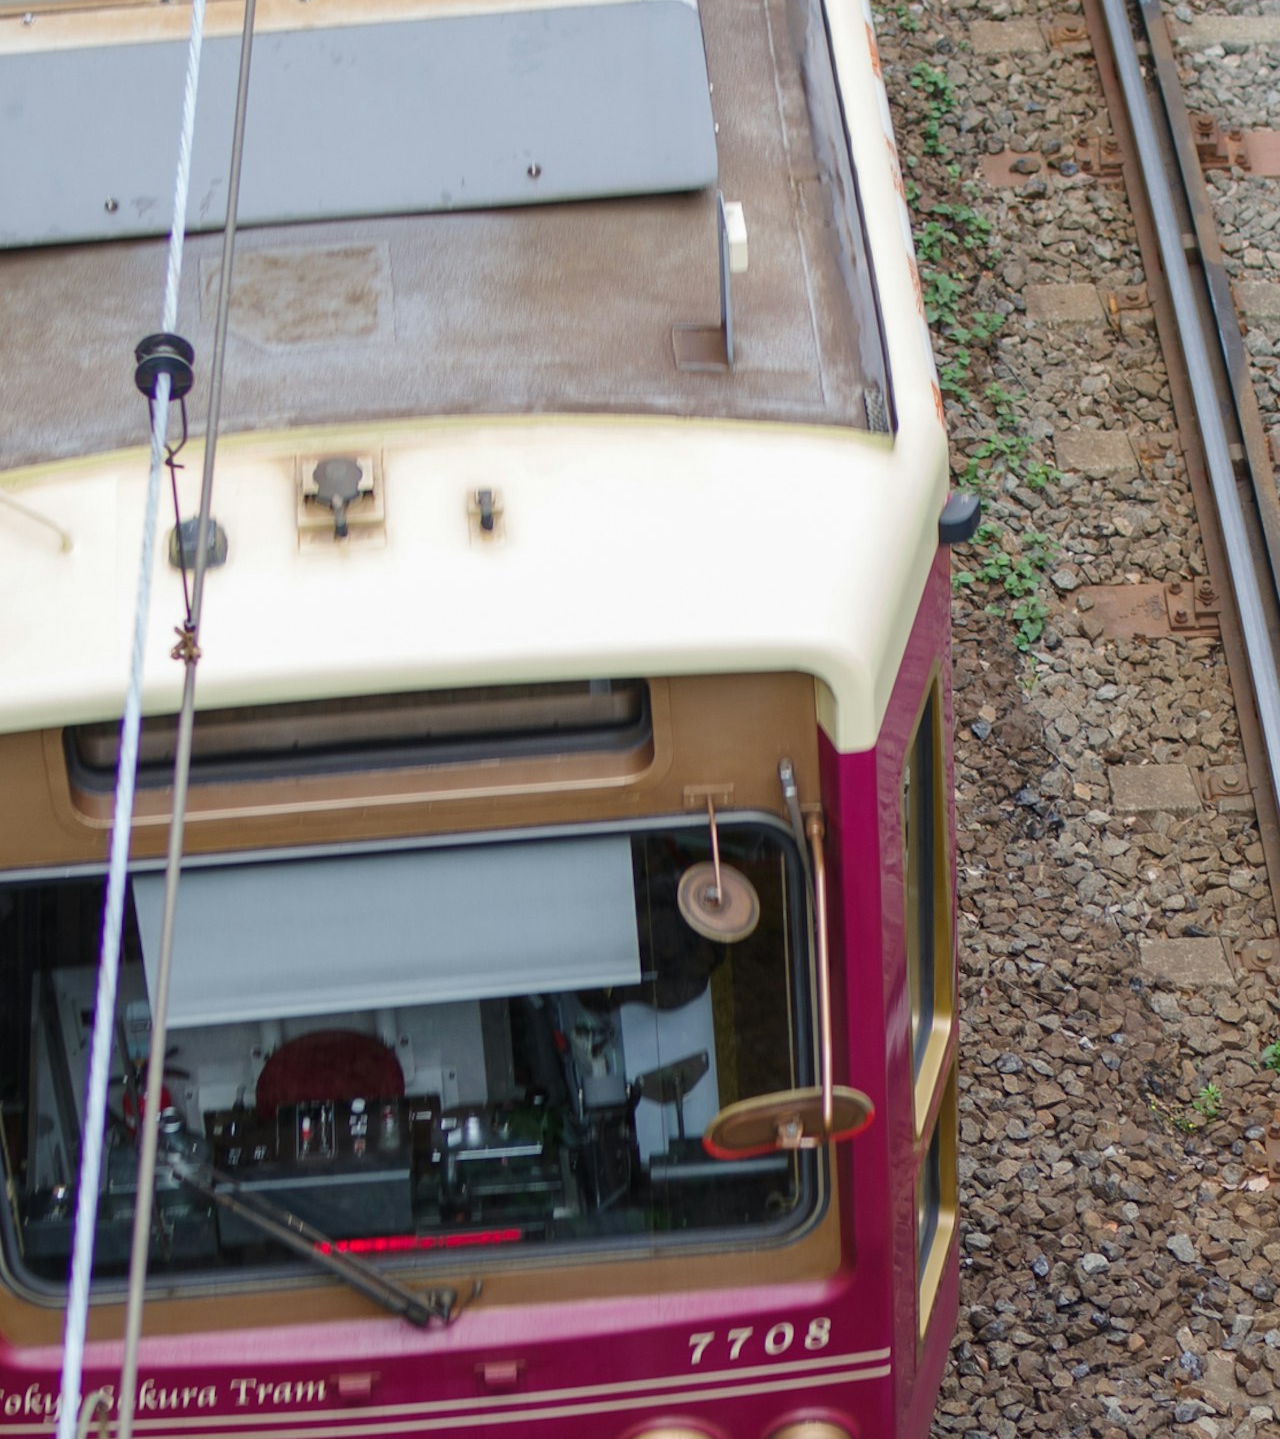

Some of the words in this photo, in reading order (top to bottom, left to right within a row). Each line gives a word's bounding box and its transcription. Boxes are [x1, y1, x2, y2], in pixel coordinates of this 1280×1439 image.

[688, 1316, 832, 1366] 7708
[96, 1377, 218, 1413] Skura
[229, 1377, 327, 1408] Tram
